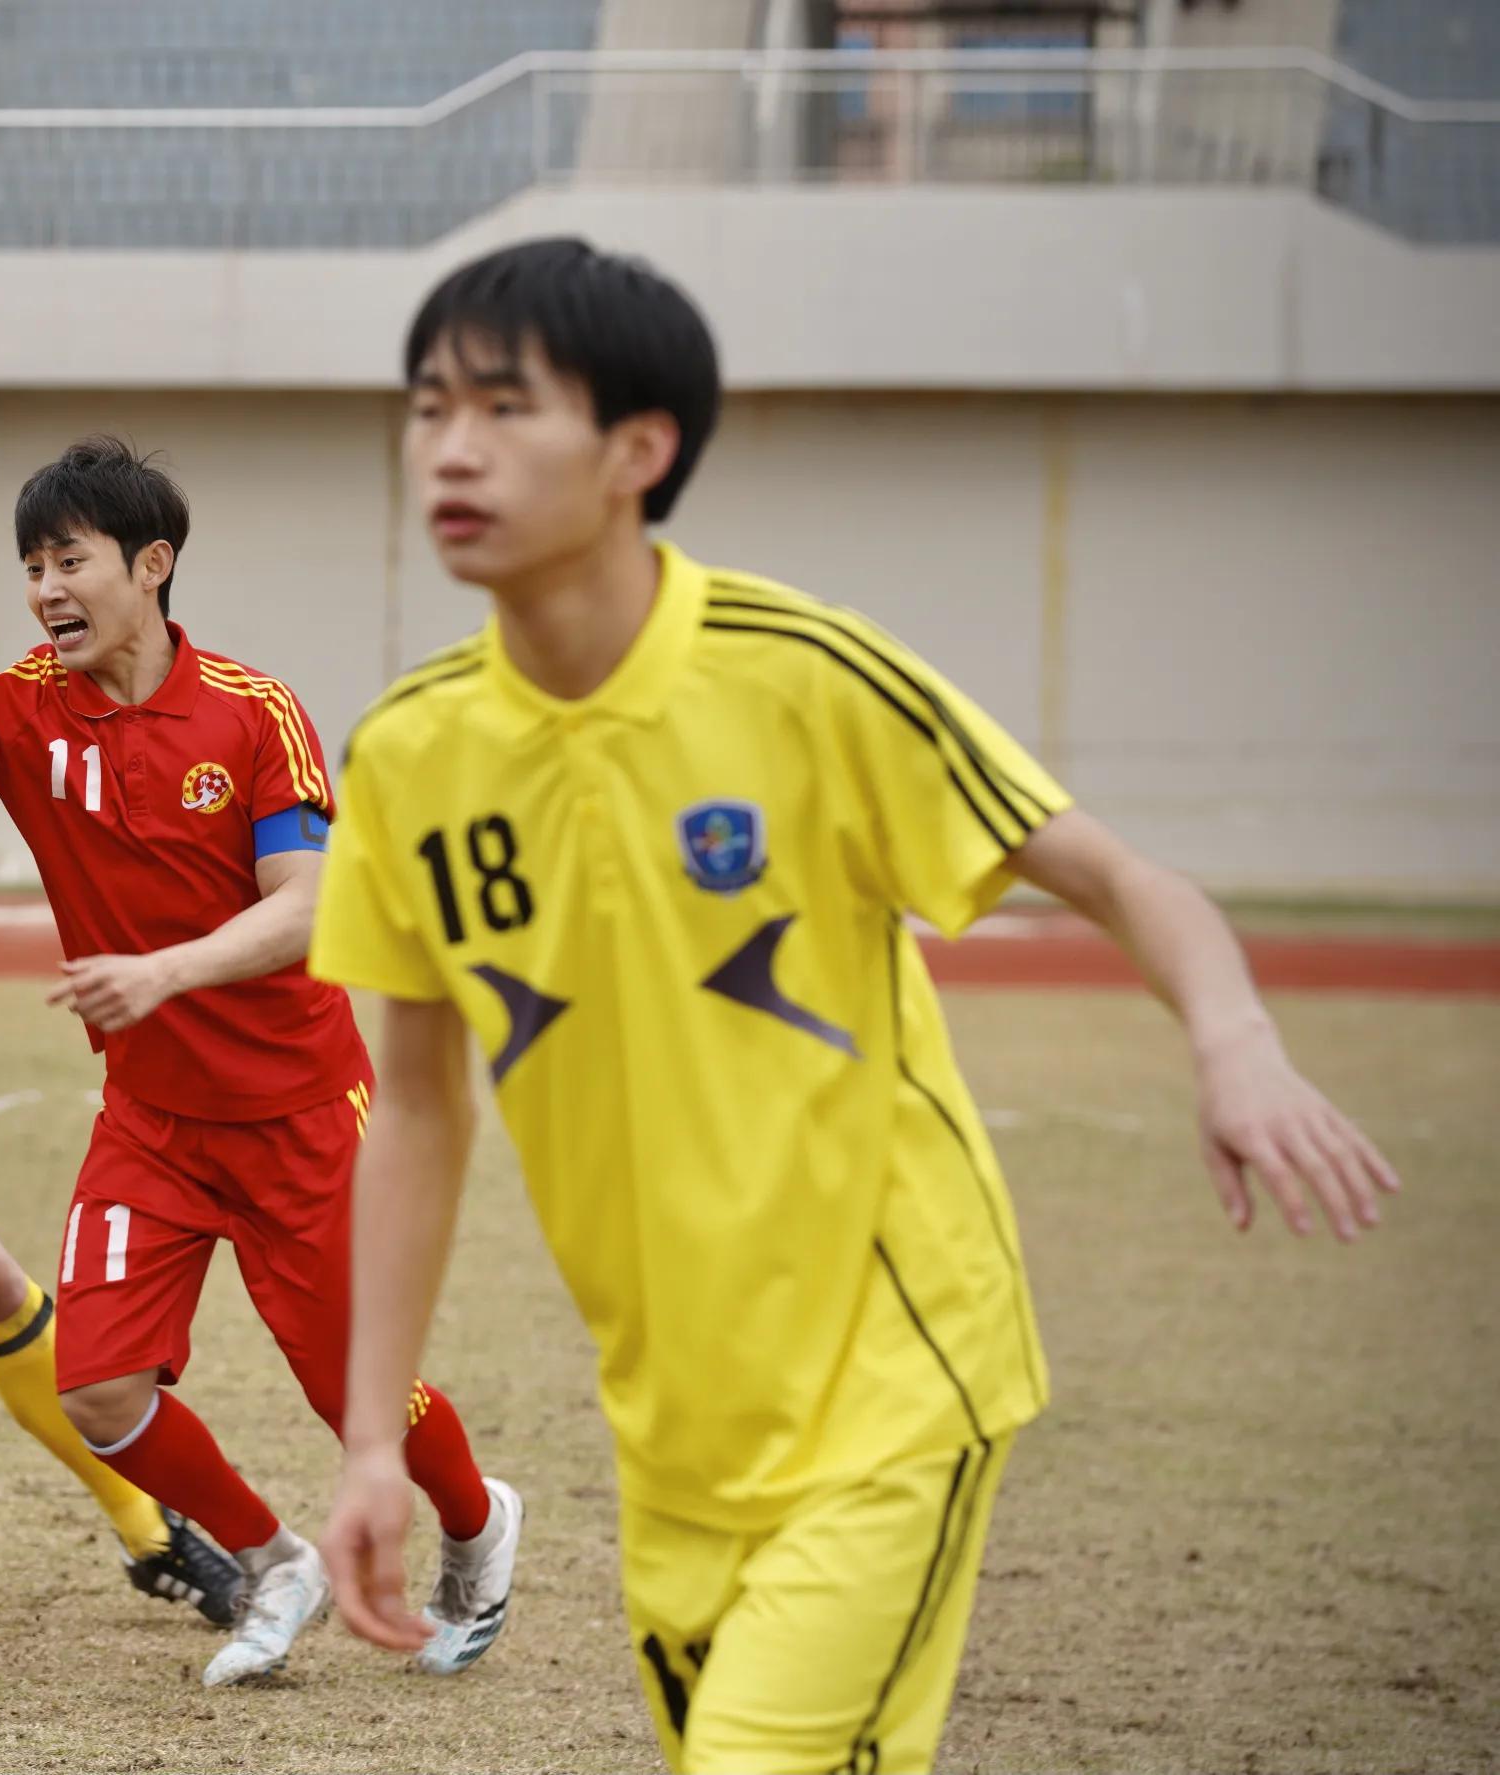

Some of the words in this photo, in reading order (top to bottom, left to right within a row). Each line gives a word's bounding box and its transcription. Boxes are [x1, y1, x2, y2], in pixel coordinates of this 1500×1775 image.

[48, 738, 102, 812] 11
[418, 814, 534, 943] 18
[61, 1202, 131, 1284] 11
